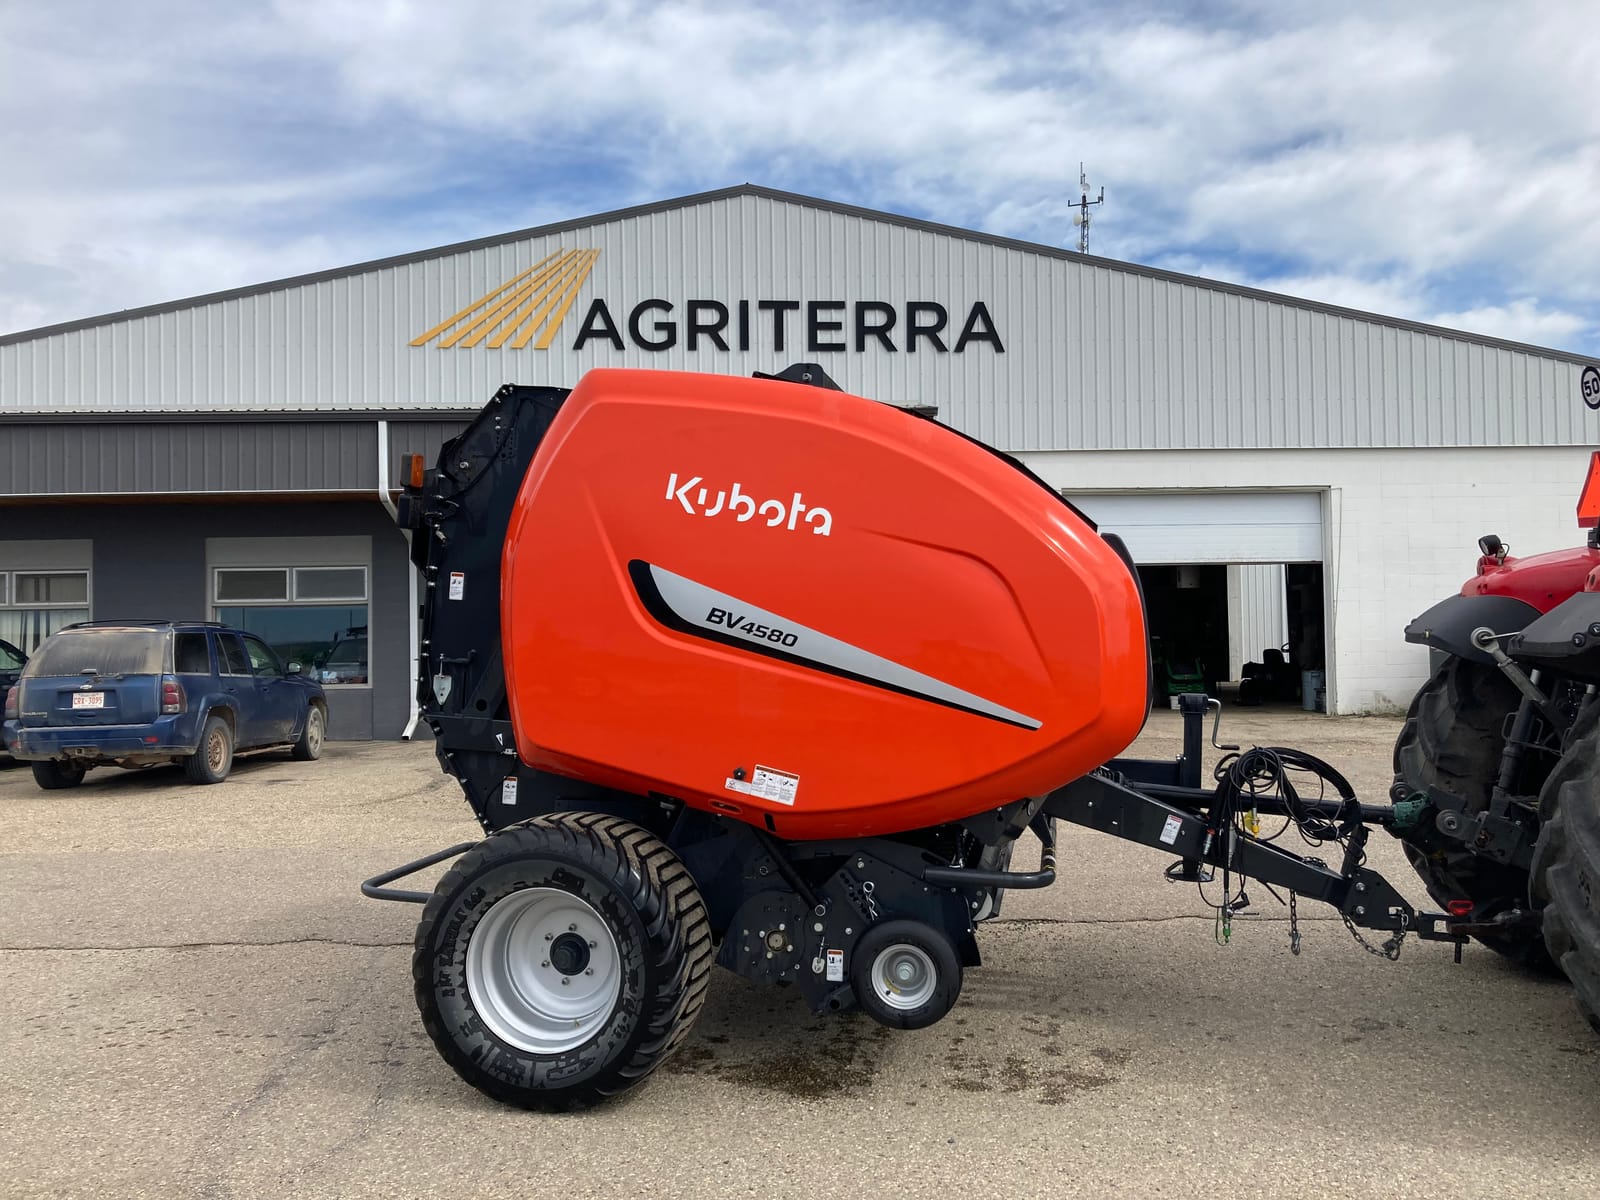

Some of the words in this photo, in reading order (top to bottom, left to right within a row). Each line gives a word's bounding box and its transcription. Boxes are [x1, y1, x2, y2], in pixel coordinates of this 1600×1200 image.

[573, 298, 1005, 353] AGRITERRA
[1584, 377, 1600, 397] 50
[665, 473, 833, 536] Kubota
[706, 607, 798, 647] BV4580
